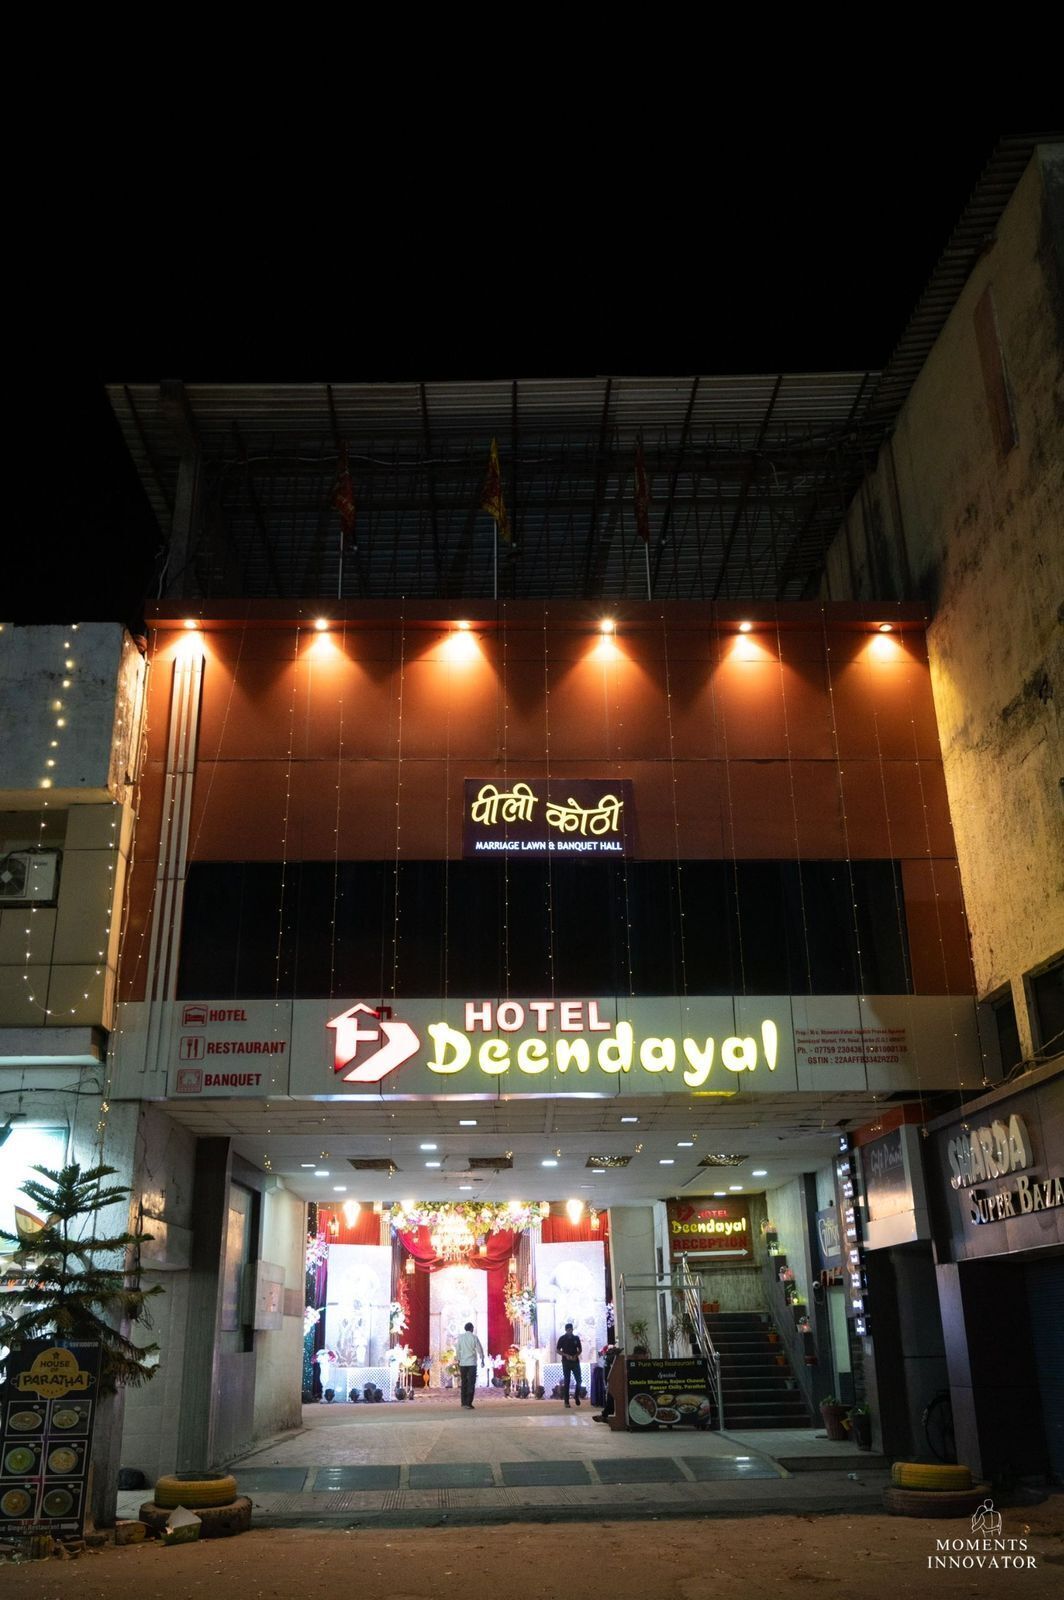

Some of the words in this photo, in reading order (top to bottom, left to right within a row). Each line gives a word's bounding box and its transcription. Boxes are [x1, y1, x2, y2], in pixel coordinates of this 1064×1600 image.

[471, 782, 538, 826] पीली
[545, 794, 624, 836] कोठी
[475, 841, 519, 850] MARRIAGE
[521, 841, 546, 850] LAWN
[548, 841, 555, 850] &
[557, 841, 598, 852] BANQUET
[600, 841, 622, 850] HALL
[209, 1009, 247, 1022] HOTEL
[464, 1001, 611, 1033] HOTEL
[207, 1041, 286, 1055] RESTAURANT
[426, 1018, 779, 1088] Deendayal
[204, 1073, 262, 1087] BANQUET
[947, 1113, 1032, 1190] SHARDA
[968, 1188, 1016, 1225] SUPER
[671, 1217, 747, 1235] Deendayal
[672, 1236, 748, 1250] RECEPTION
[40, 1360, 71, 1368] HOUSE
[23, 1374, 84, 1387] PARATHA
